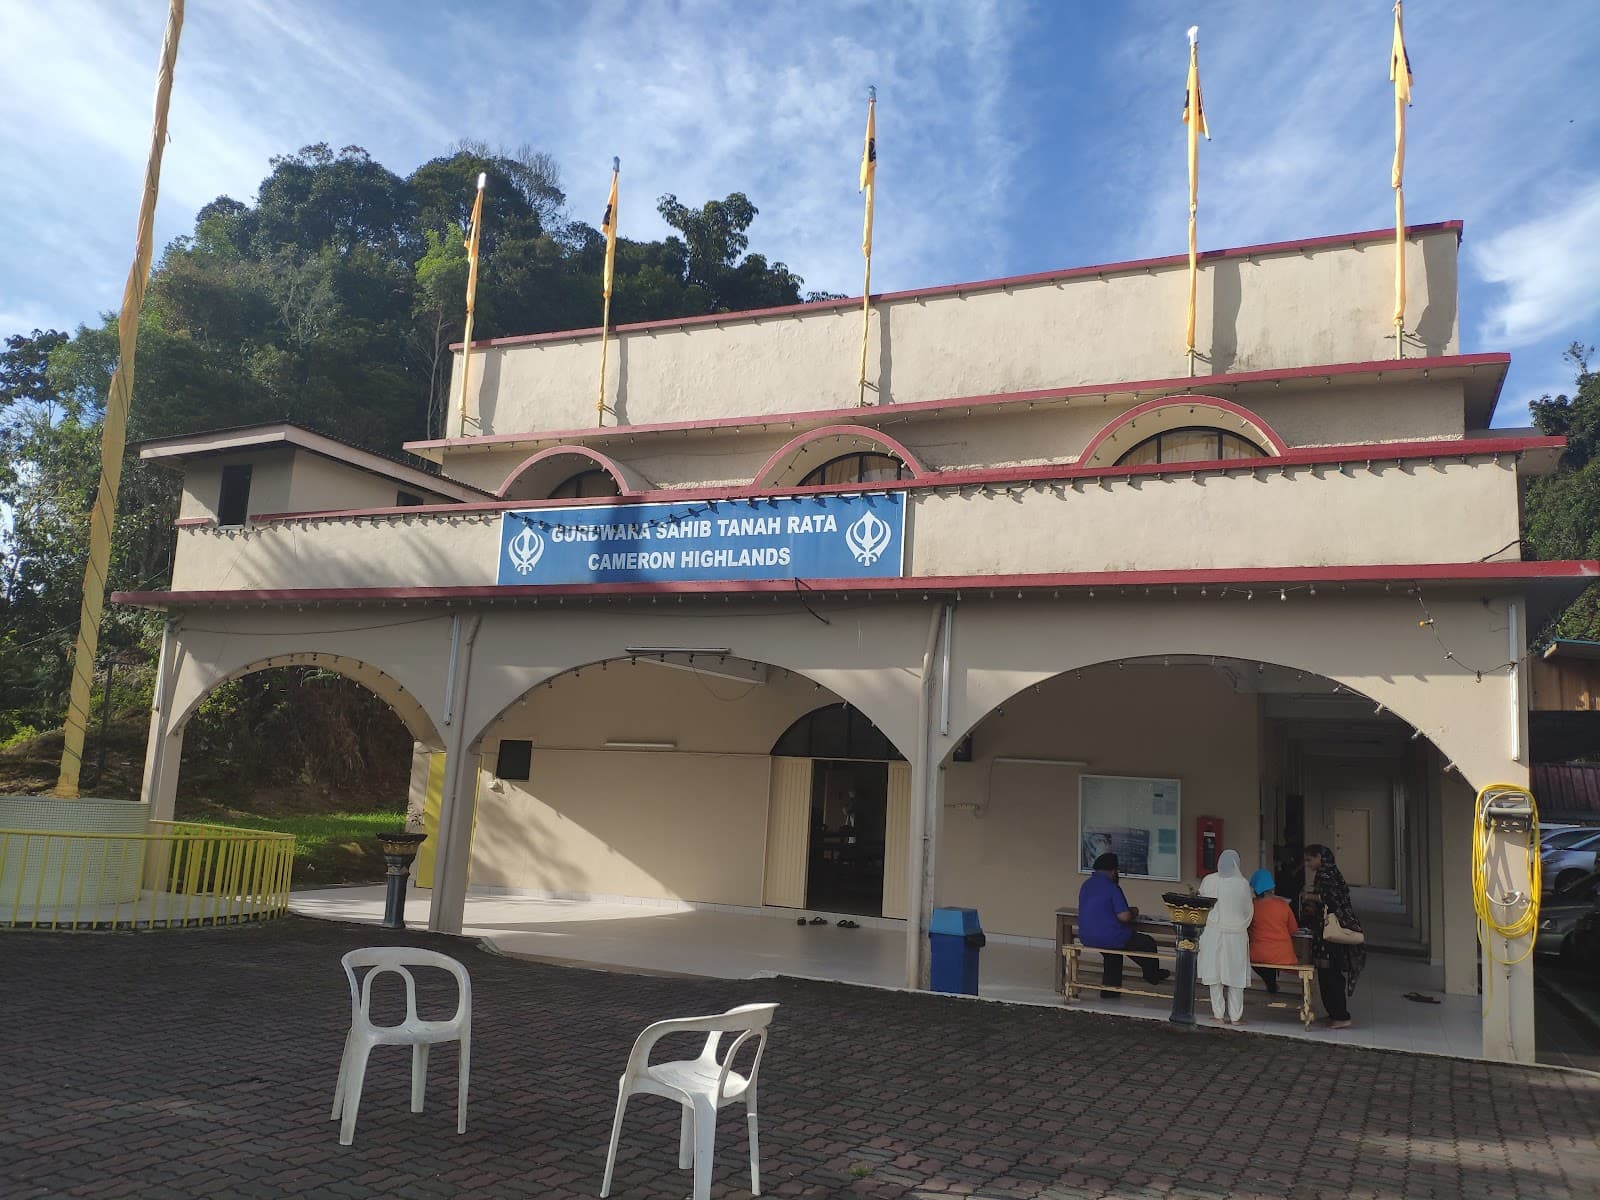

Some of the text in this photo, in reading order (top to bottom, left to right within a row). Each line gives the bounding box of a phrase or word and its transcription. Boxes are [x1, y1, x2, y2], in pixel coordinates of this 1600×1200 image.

[551, 514, 838, 543] GURDWARA SAHIB TANAH RATA
[588, 547, 791, 571] CAMERON HIGHLANDS
